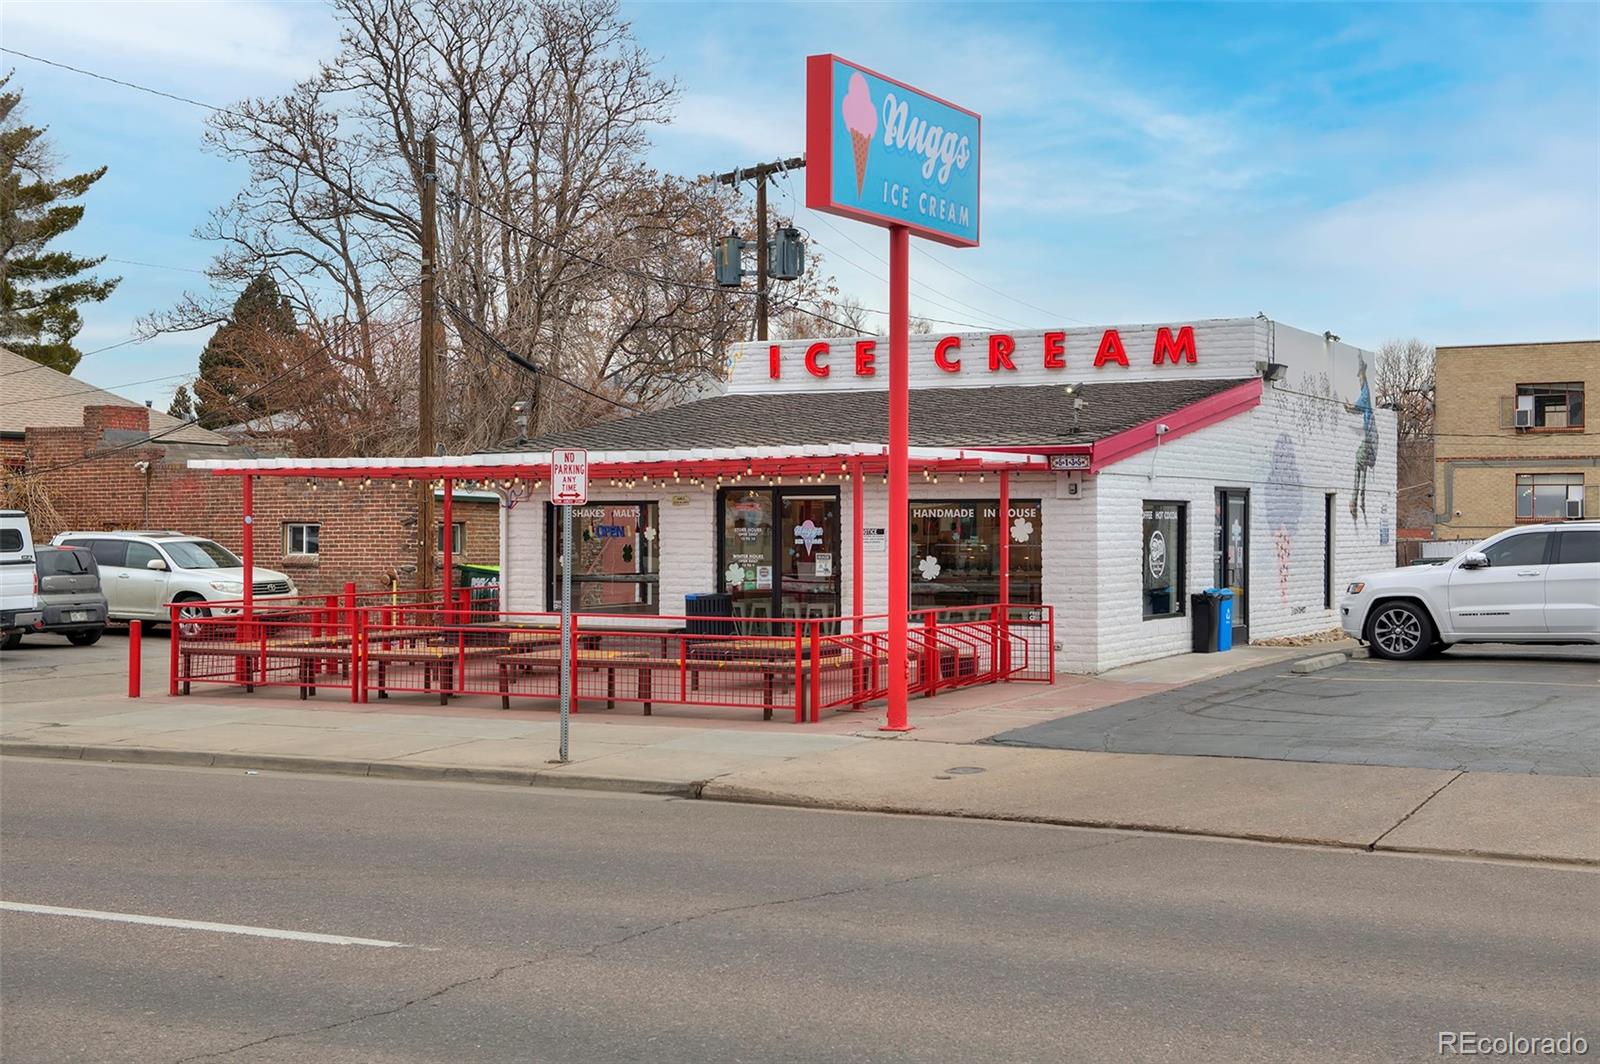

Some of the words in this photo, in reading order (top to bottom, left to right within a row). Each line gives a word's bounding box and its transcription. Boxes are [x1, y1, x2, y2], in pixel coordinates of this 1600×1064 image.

[883, 93, 970, 184] Nuggs
[883, 181, 909, 209] ICE
[919, 192, 969, 227] CREAM
[768, 340, 876, 380] ICE
[934, 326, 1197, 373] CREAM
[564, 452, 575, 463] NO
[554, 464, 585, 475] PARKING
[562, 484, 577, 492] TIME
[572, 509, 606, 518] SHAKES
[613, 509, 641, 518] MALTS
[913, 508, 974, 518] HANDMADE
[983, 508, 996, 517] IN
[999, 508, 1037, 518] OUSE
[596, 525, 625, 538] OPEN
